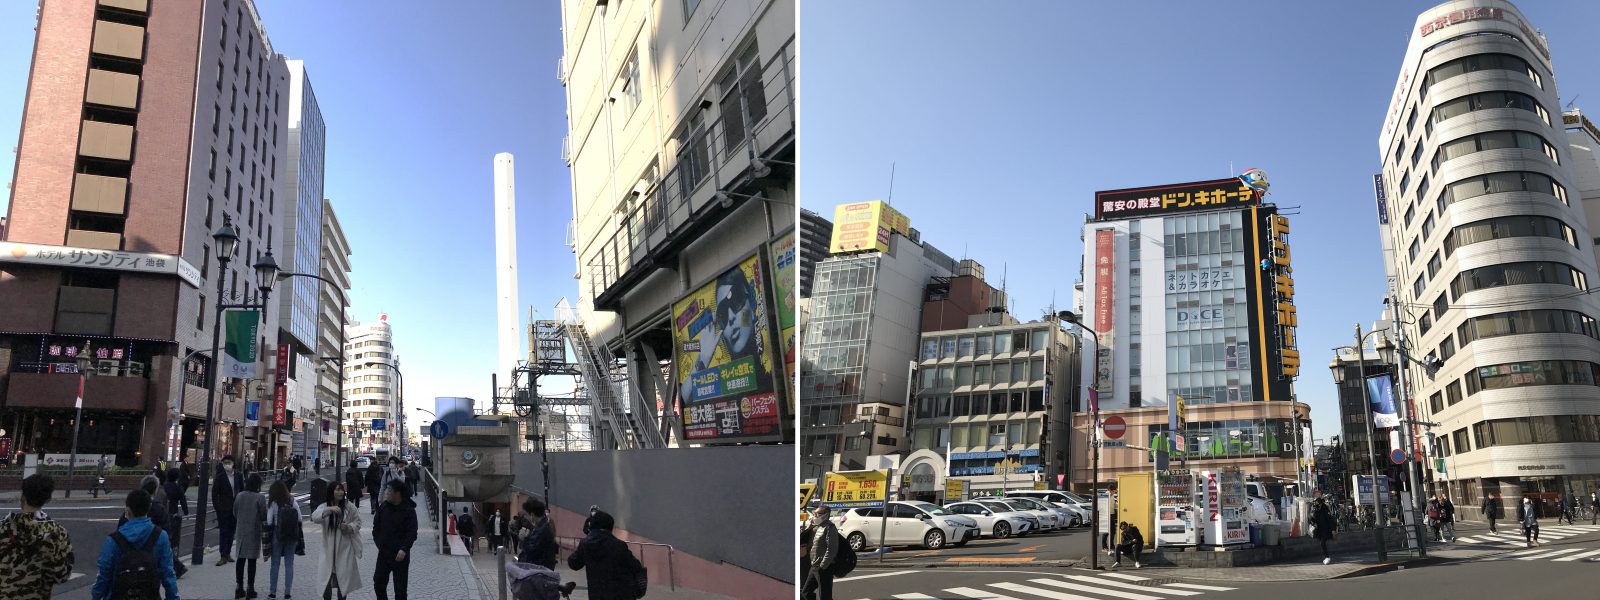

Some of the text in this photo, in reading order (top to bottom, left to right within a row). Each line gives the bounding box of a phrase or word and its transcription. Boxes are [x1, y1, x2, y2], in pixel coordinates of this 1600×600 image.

[1103, 197, 1161, 212] 驚安の殿堂
[878, 227, 889, 238] 24H
[36, 250, 166, 268] ホテル サンシティ 池袋
[1168, 271, 1230, 282] ネットカフェ
[751, 395, 776, 407] パーフェクト
[751, 405, 770, 416] システム
[1207, 473, 1219, 522] KIRIN
[1227, 529, 1246, 539] KIRIN
